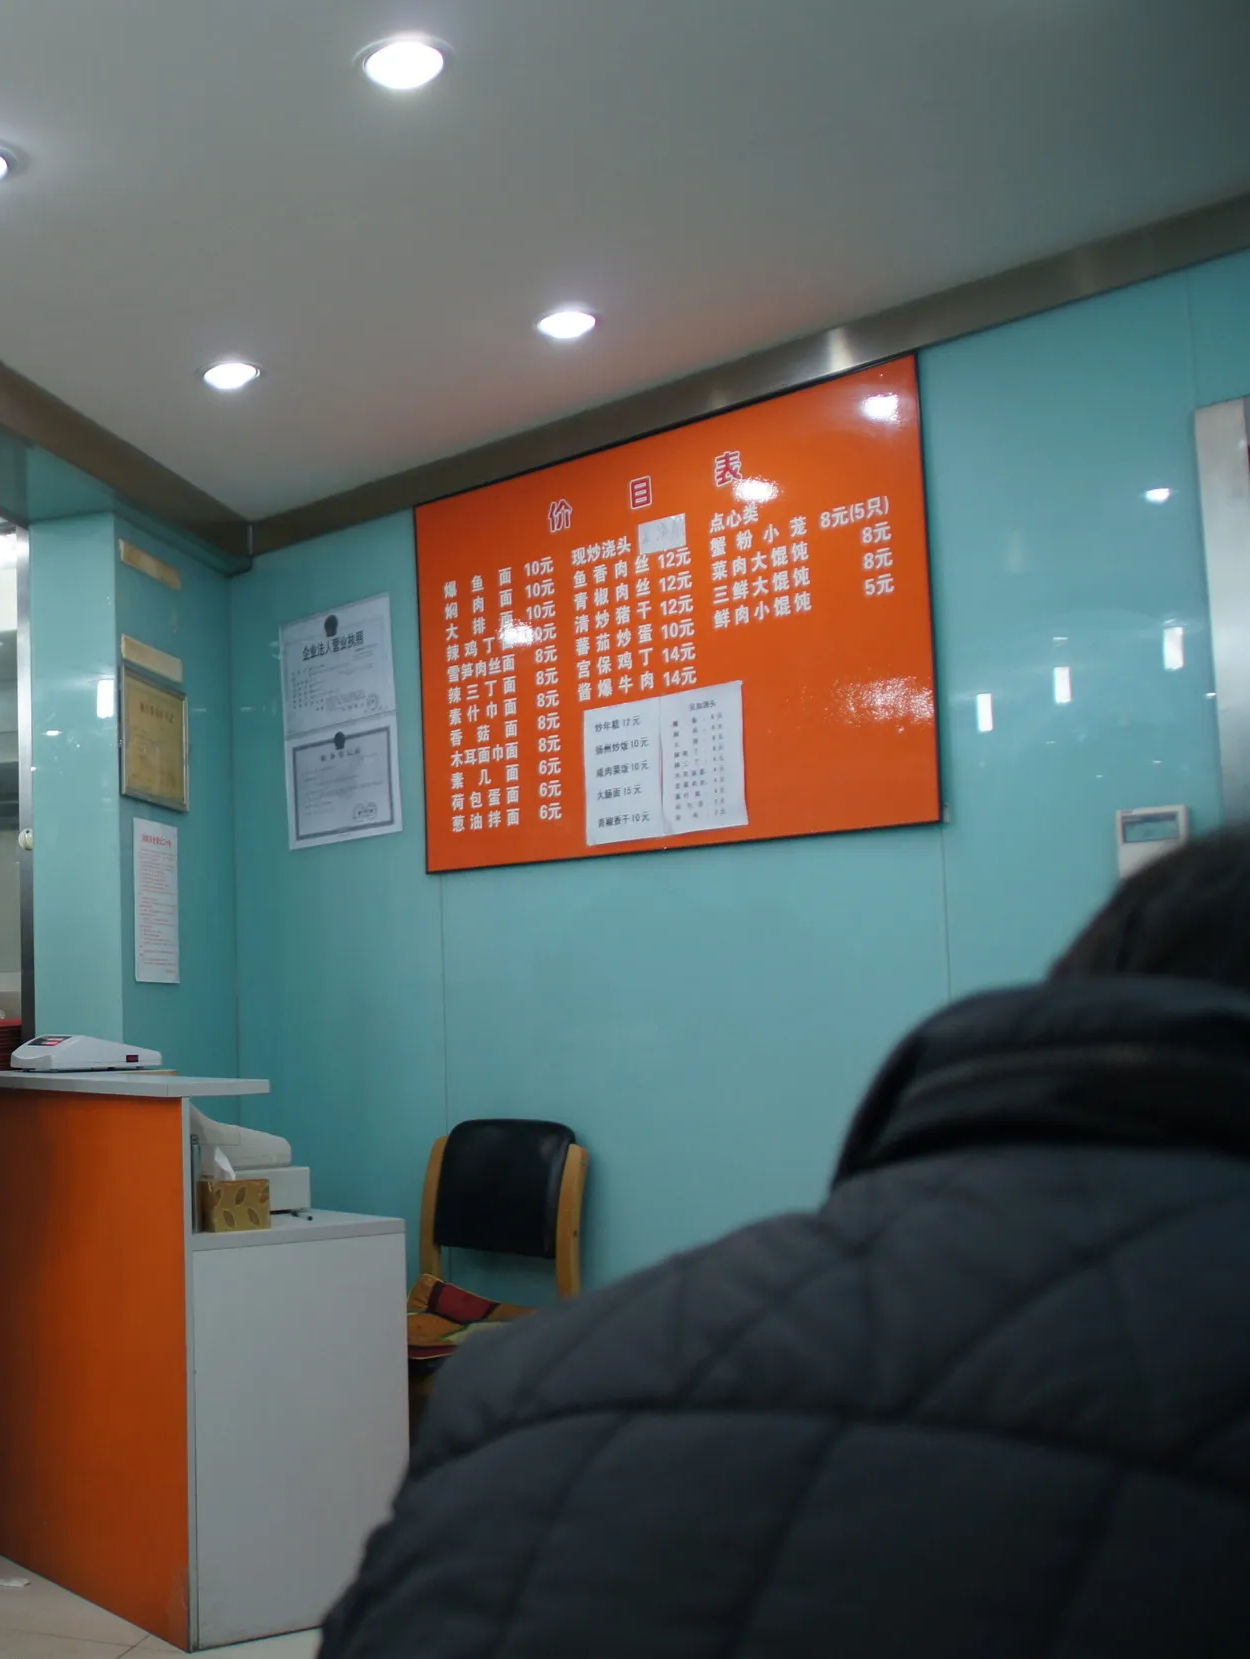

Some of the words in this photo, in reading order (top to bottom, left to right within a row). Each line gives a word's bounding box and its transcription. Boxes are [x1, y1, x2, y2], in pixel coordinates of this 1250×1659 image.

[548, 451, 742, 532] 价目表
[524, 556, 554, 577] 10元
[572, 535, 631, 566] 现炒浇头
[573, 554, 649, 589] 鱼香肉丝
[658, 547, 691, 569] 12元
[712, 541, 809, 580] 菜肉大馄饨
[862, 521, 891, 544] 8元
[525, 578, 555, 598] 10元
[574, 577, 650, 611] 青椒肉丝
[659, 571, 692, 592] 12元
[713, 566, 810, 604] 三鲜大馄饨
[863, 547, 893, 569] 8元
[526, 600, 556, 620] 10元
[575, 600, 651, 634] 清炒猪干
[660, 594, 693, 616] 12元
[714, 591, 812, 629] 鲜肉小馄饨
[864, 573, 895, 596] 5元
[302, 629, 365, 661] 企业法人营业执照
[661, 619, 695, 639] 10元
[535, 645, 558, 663] 8元
[577, 648, 653, 679] 宫保鸡丁
[662, 642, 696, 663] 14元
[448, 676, 516, 704] 辣三丁面
[536, 667, 559, 686] 8元
[578, 671, 654, 701] 酱爆牛肉
[663, 666, 697, 687] 14元
[449, 698, 517, 726] 素什巾面
[536, 690, 560, 708] 8元
[450, 719, 518, 747] 香菇面
[538, 712, 561, 730] 8元
[451, 741, 519, 768] 木耳面巾面
[538, 734, 561, 753] 8元
[451, 763, 519, 790] 素几面
[539, 757, 562, 775] 6元
[452, 785, 520, 811] 荷包蛋面
[539, 779, 562, 797] 6元
[452, 808, 520, 832] 葱油拌面
[539, 802, 562, 820] 6元
